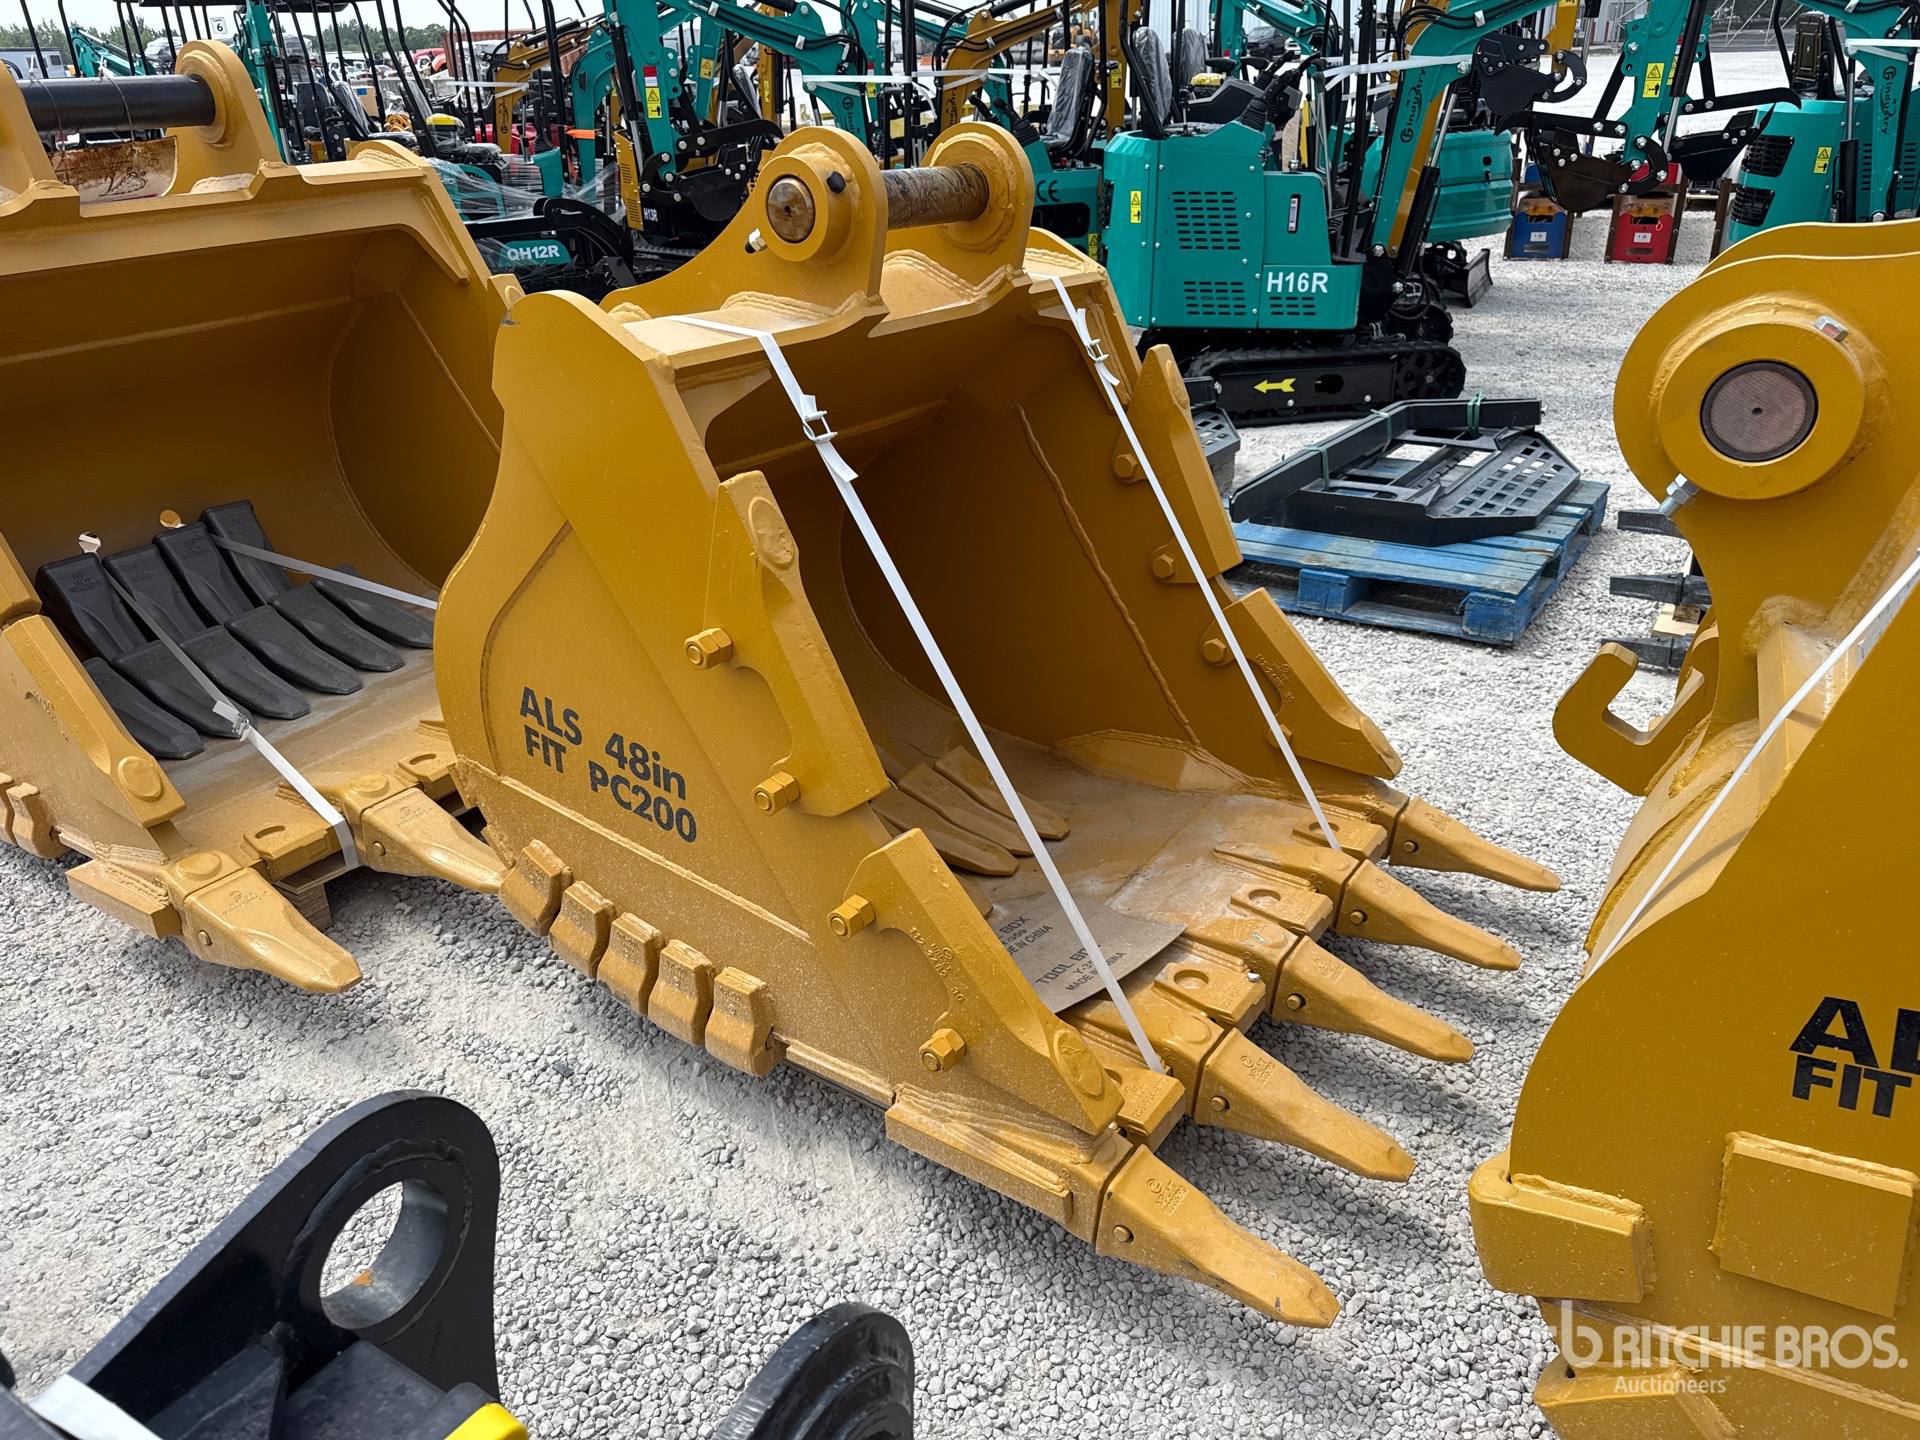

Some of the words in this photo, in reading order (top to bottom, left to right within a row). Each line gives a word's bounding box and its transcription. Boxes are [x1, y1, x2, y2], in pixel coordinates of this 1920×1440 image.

[216, 23, 224, 32] 6
[1036, 180, 1060, 202] CE
[507, 245, 560, 261] QH12R
[1267, 272, 1328, 293] H16R
[520, 686, 582, 746] ALS
[605, 732, 686, 800] 48in
[524, 725, 566, 774] FIT
[588, 760, 697, 843] PC200
[999, 916, 1031, 933] BOX
[1025, 925, 1053, 943] CHINA
[1035, 963, 1075, 984] TOOL
[1065, 974, 1094, 990] MADE
[1792, 1054, 1912, 1118] FIT
